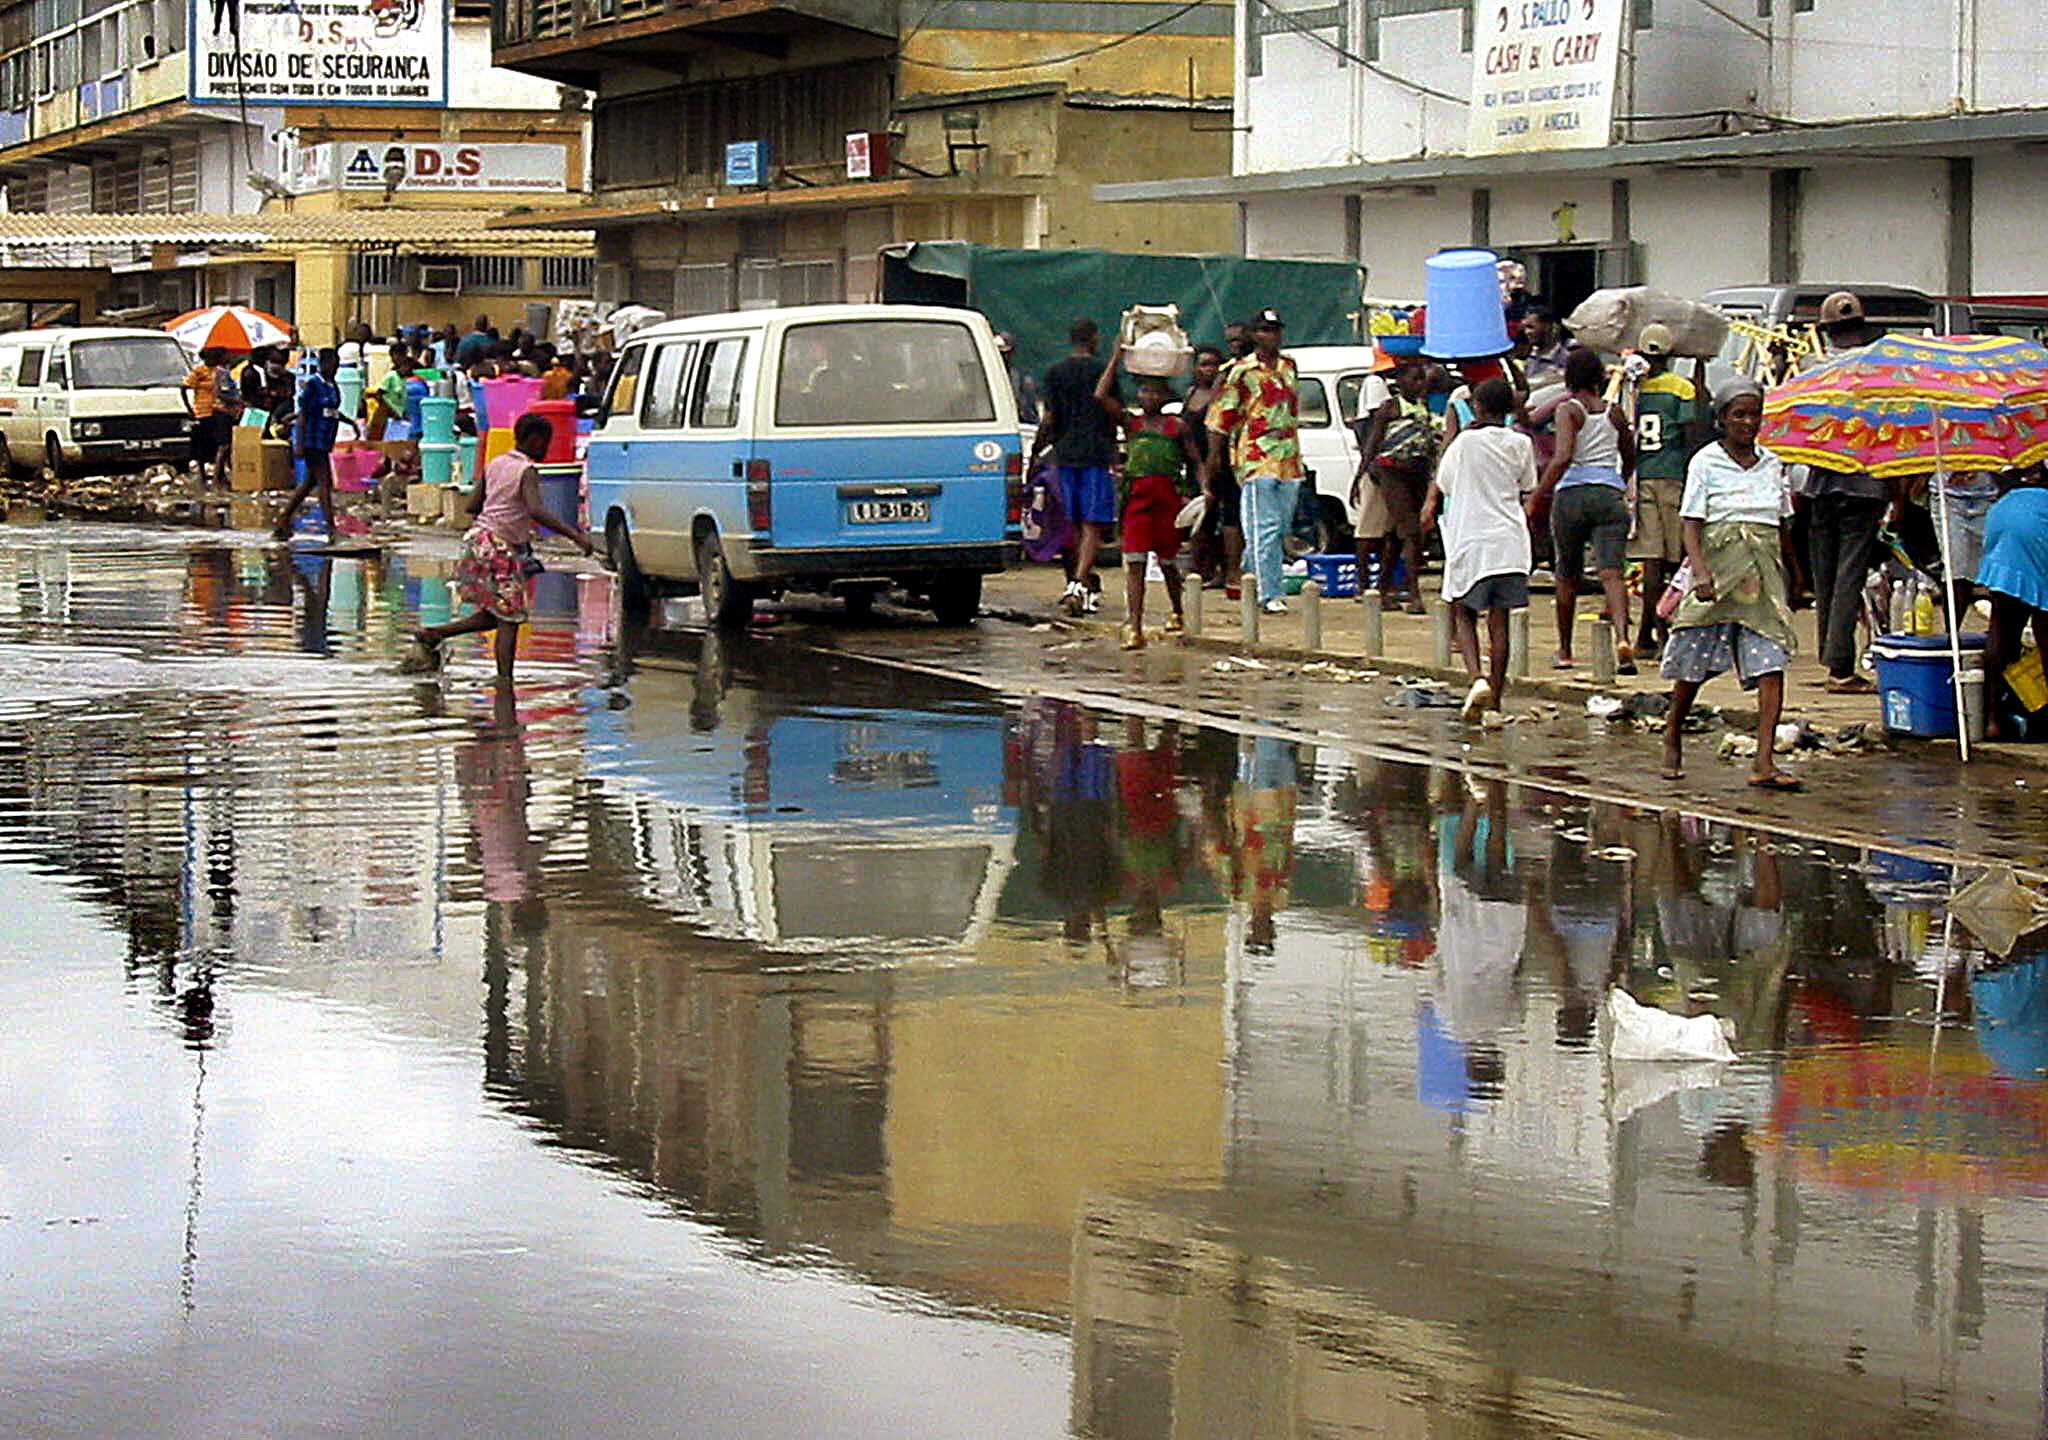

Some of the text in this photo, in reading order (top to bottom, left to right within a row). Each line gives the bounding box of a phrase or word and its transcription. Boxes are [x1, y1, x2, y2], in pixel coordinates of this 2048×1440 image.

[208, 48, 430, 82] DIVSÃO DE SEGURANÇA
[1486, 42, 1522, 75] CASH
[1552, 32, 1602, 67] CARRY
[414, 149, 481, 176] D.S
